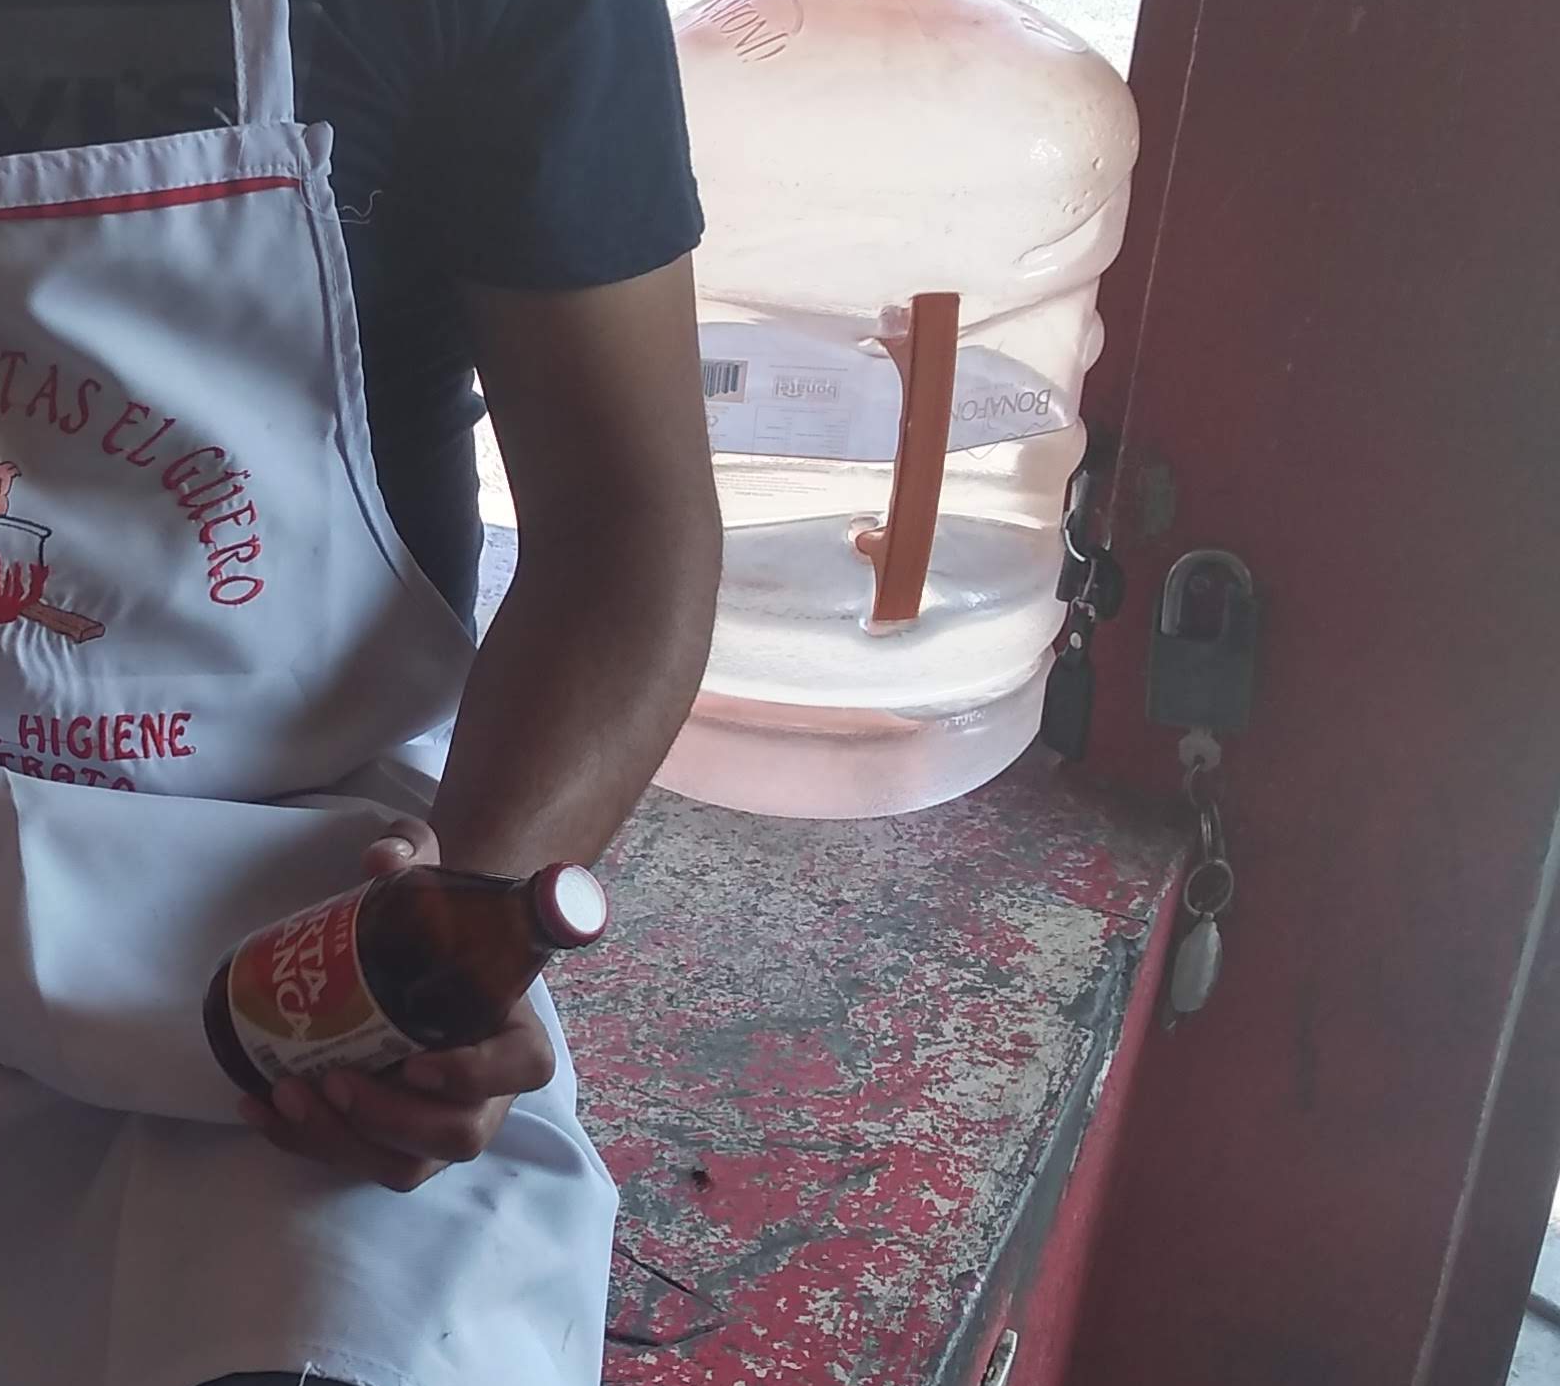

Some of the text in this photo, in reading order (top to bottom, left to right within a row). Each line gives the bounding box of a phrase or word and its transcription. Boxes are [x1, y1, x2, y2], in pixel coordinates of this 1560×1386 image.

[101, 399, 177, 468] EL
[950, 387, 1053, 424] BONAFON
[18, 711, 197, 763] HIGIENE
[272, 919, 313, 1042] ANCA
[296, 906, 333, 1005] RTA
